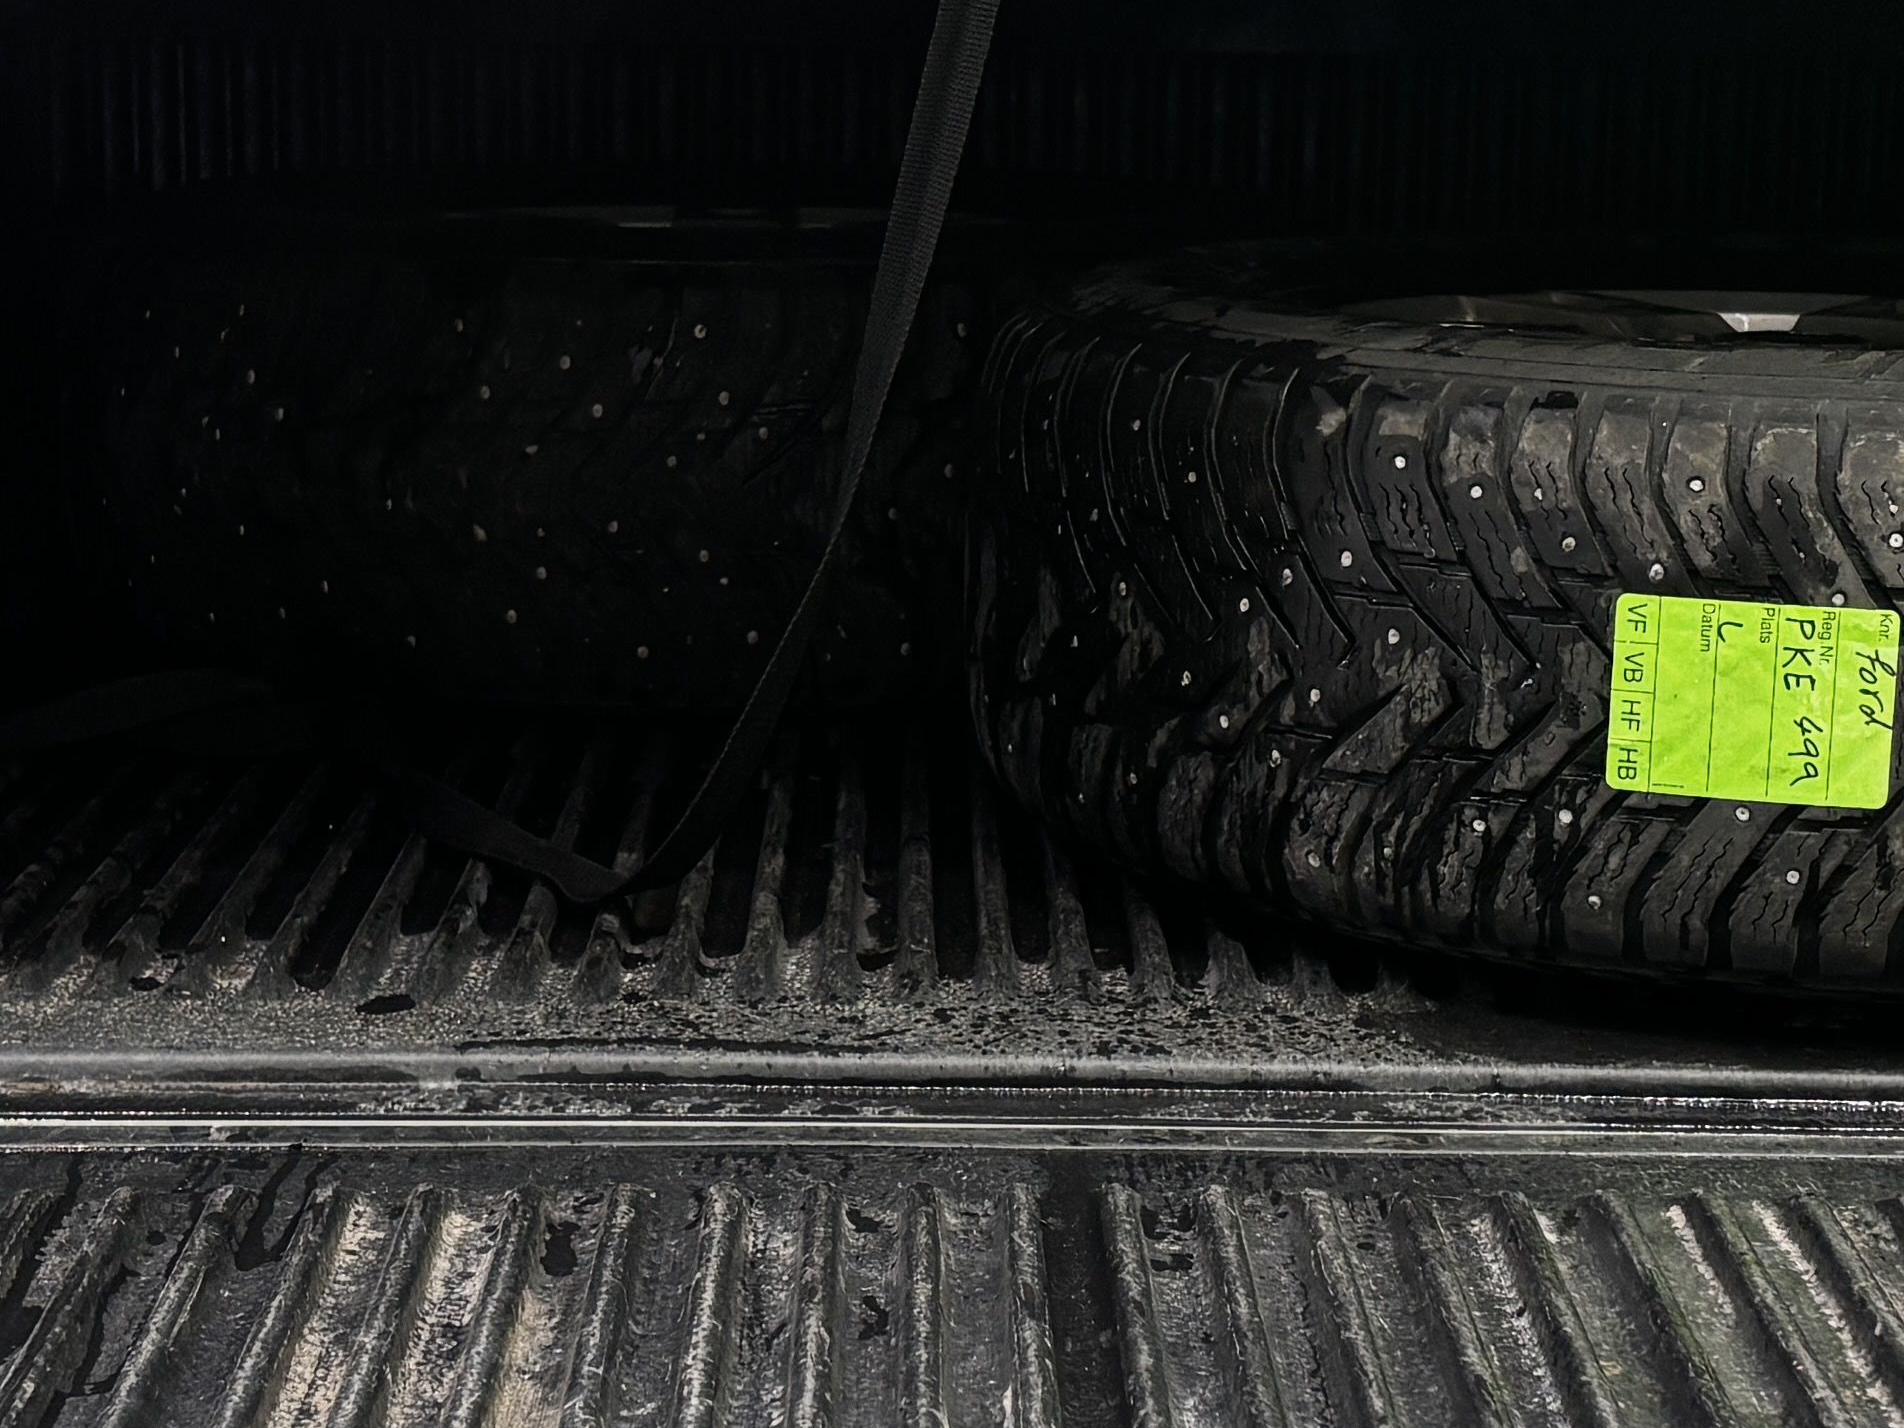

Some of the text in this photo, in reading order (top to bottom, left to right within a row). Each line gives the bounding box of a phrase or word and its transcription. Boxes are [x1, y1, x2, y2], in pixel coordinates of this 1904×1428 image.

[1699, 603, 1717, 653] Datum
[1759, 606, 1777, 644] Plats
[1877, 613, 1895, 642] Knr.
[1782, 616, 1817, 692] PKE
[1617, 603, 1648, 781] VF VB HF HB
